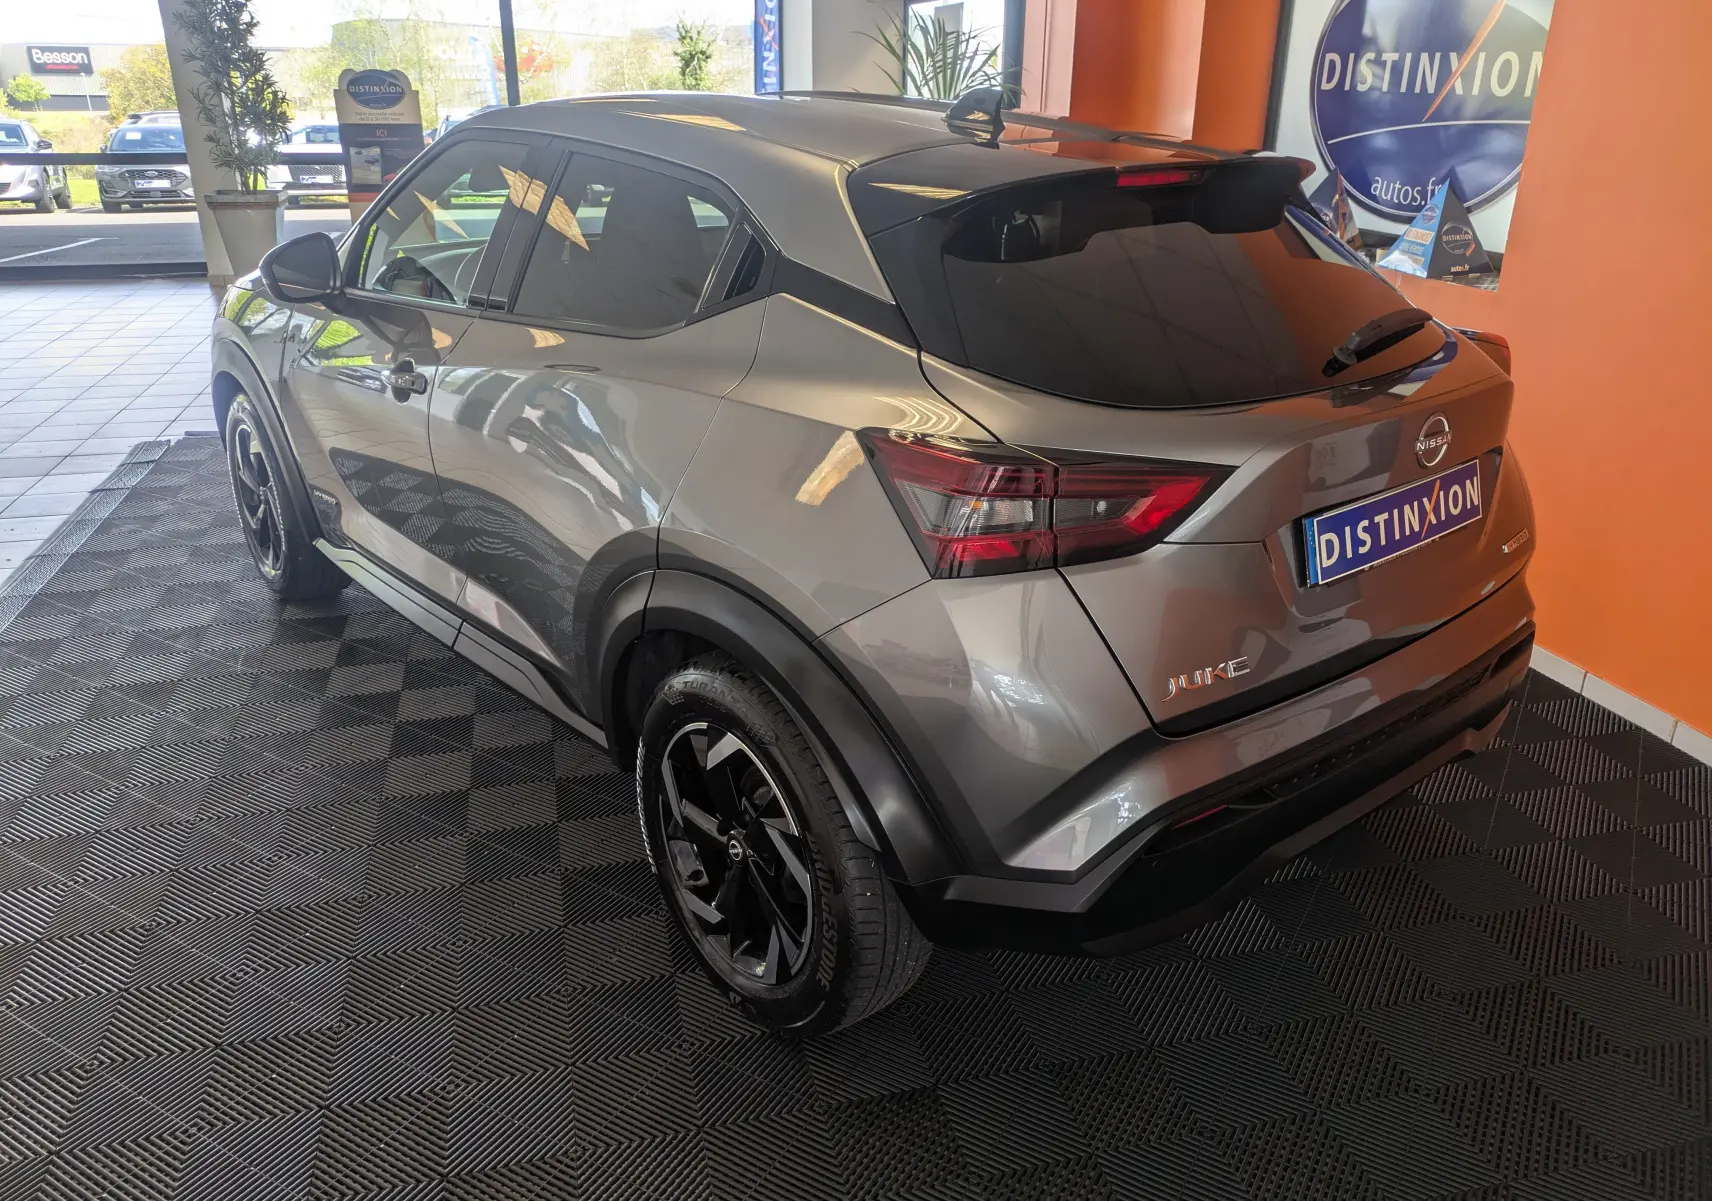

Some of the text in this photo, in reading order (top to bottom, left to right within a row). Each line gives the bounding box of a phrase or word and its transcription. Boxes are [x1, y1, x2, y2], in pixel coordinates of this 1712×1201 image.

[31, 48, 88, 64] Besson
[349, 85, 403, 93] DISTINXION
[376, 129, 388, 137] ICI
[1442, 233, 1472, 241] DISTINXION
[1416, 430, 1452, 451] NISSAN
[1319, 476, 1480, 569] DISTINXION
[1161, 656, 1251, 702] JUKE
